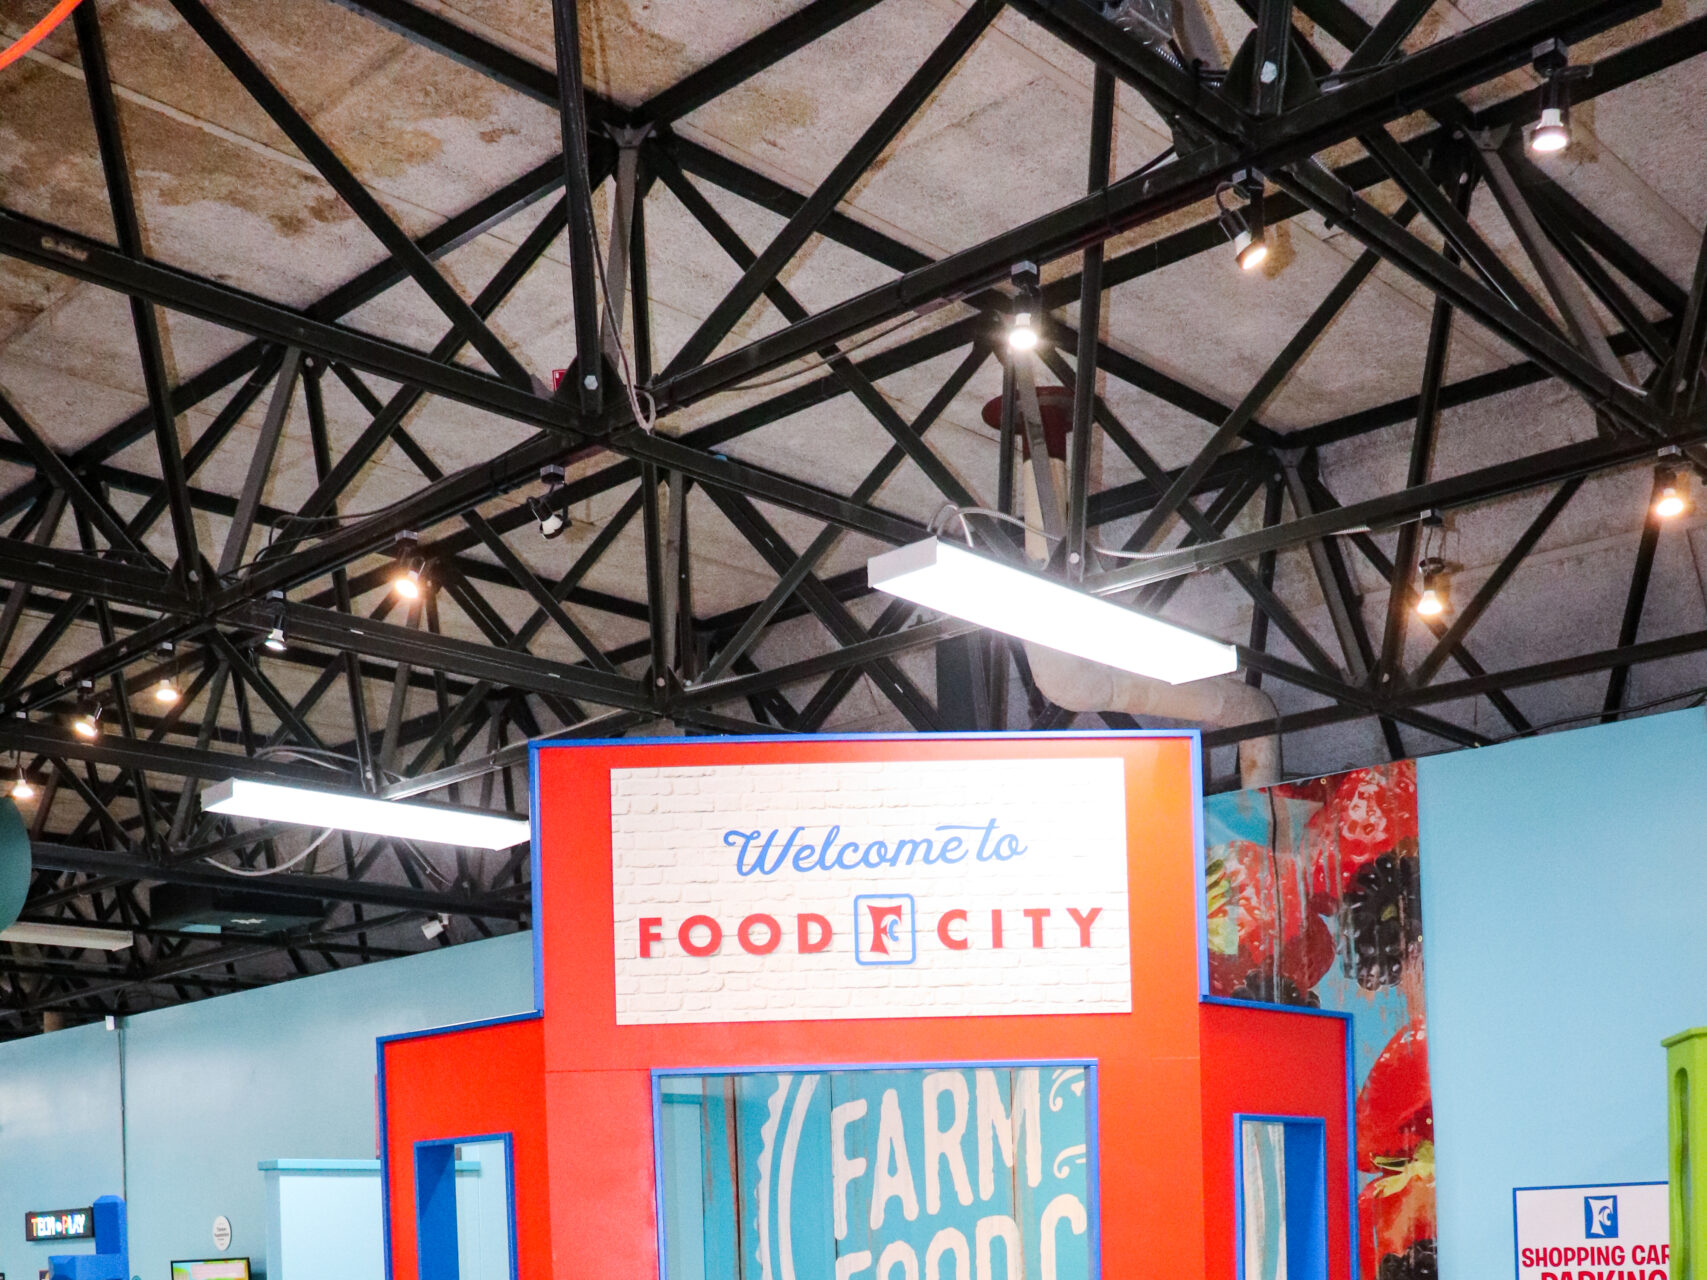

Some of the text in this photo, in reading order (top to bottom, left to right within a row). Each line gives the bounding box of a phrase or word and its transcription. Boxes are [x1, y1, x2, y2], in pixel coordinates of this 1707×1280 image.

[723, 818, 1028, 877] Welcome to
[638, 912, 834, 959] FOOD
[936, 907, 1103, 950] CITY
[831, 1068, 1042, 1241] FARM
[1521, 1244, 1670, 1268] SHOPPING CAR
